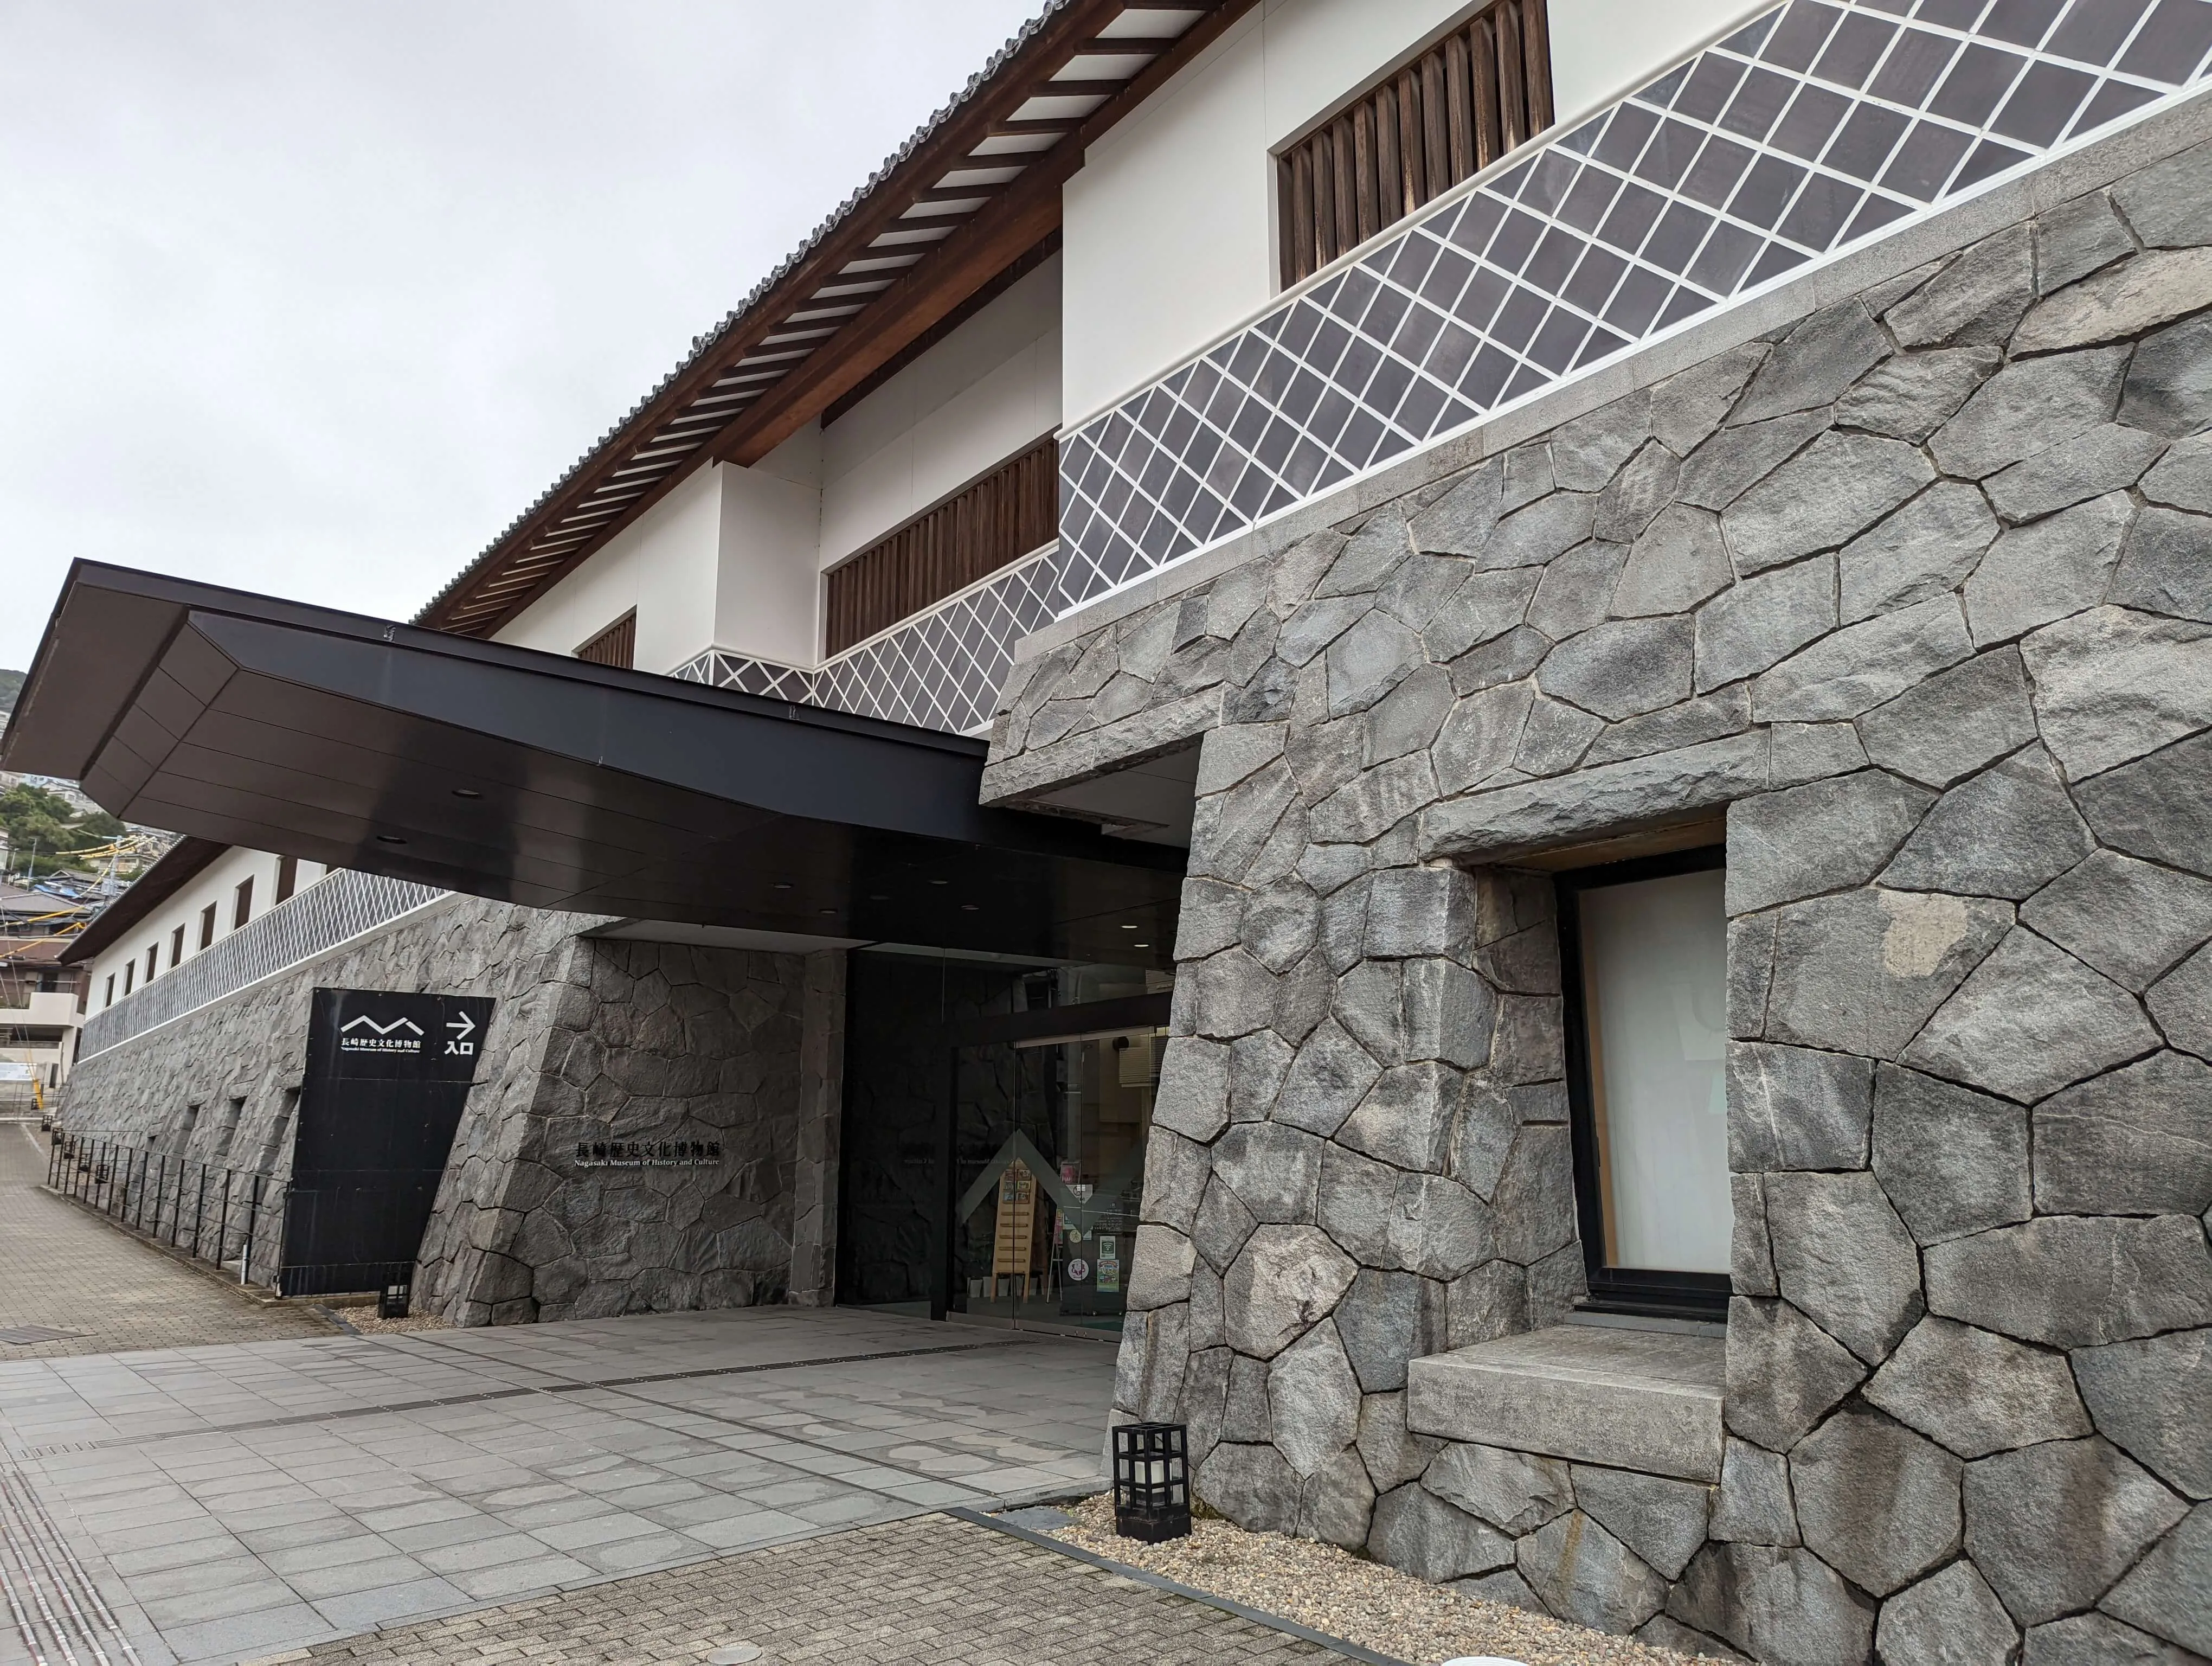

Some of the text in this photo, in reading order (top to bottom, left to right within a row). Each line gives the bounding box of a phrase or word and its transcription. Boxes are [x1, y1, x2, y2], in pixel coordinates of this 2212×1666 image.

[342, 1037, 421, 1048] 長崎歴史文化博物館
[444, 1041, 474, 1055] 入口
[576, 1141, 719, 1157] 長崎歴史文化博物館
[574, 1159, 608, 1168] Nagasaki
[652, 1159, 678, 1167] History
